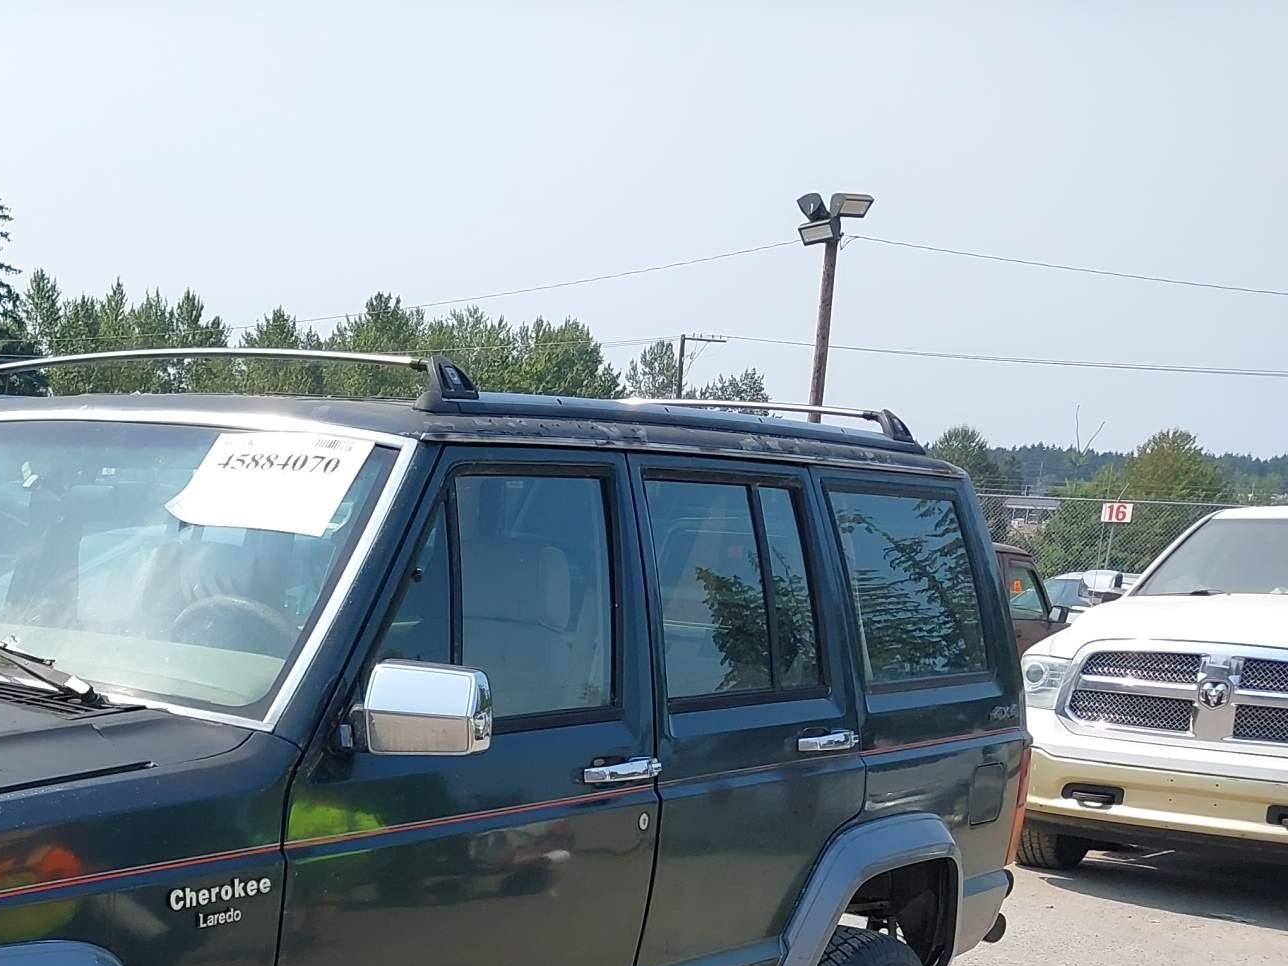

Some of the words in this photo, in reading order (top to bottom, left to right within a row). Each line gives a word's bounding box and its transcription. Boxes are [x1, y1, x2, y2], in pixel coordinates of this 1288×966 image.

[217, 453, 341, 474] 45884070
[1107, 504, 1127, 521] 16
[169, 877, 272, 911] Cherokee
[198, 908, 242, 928] Laredo
